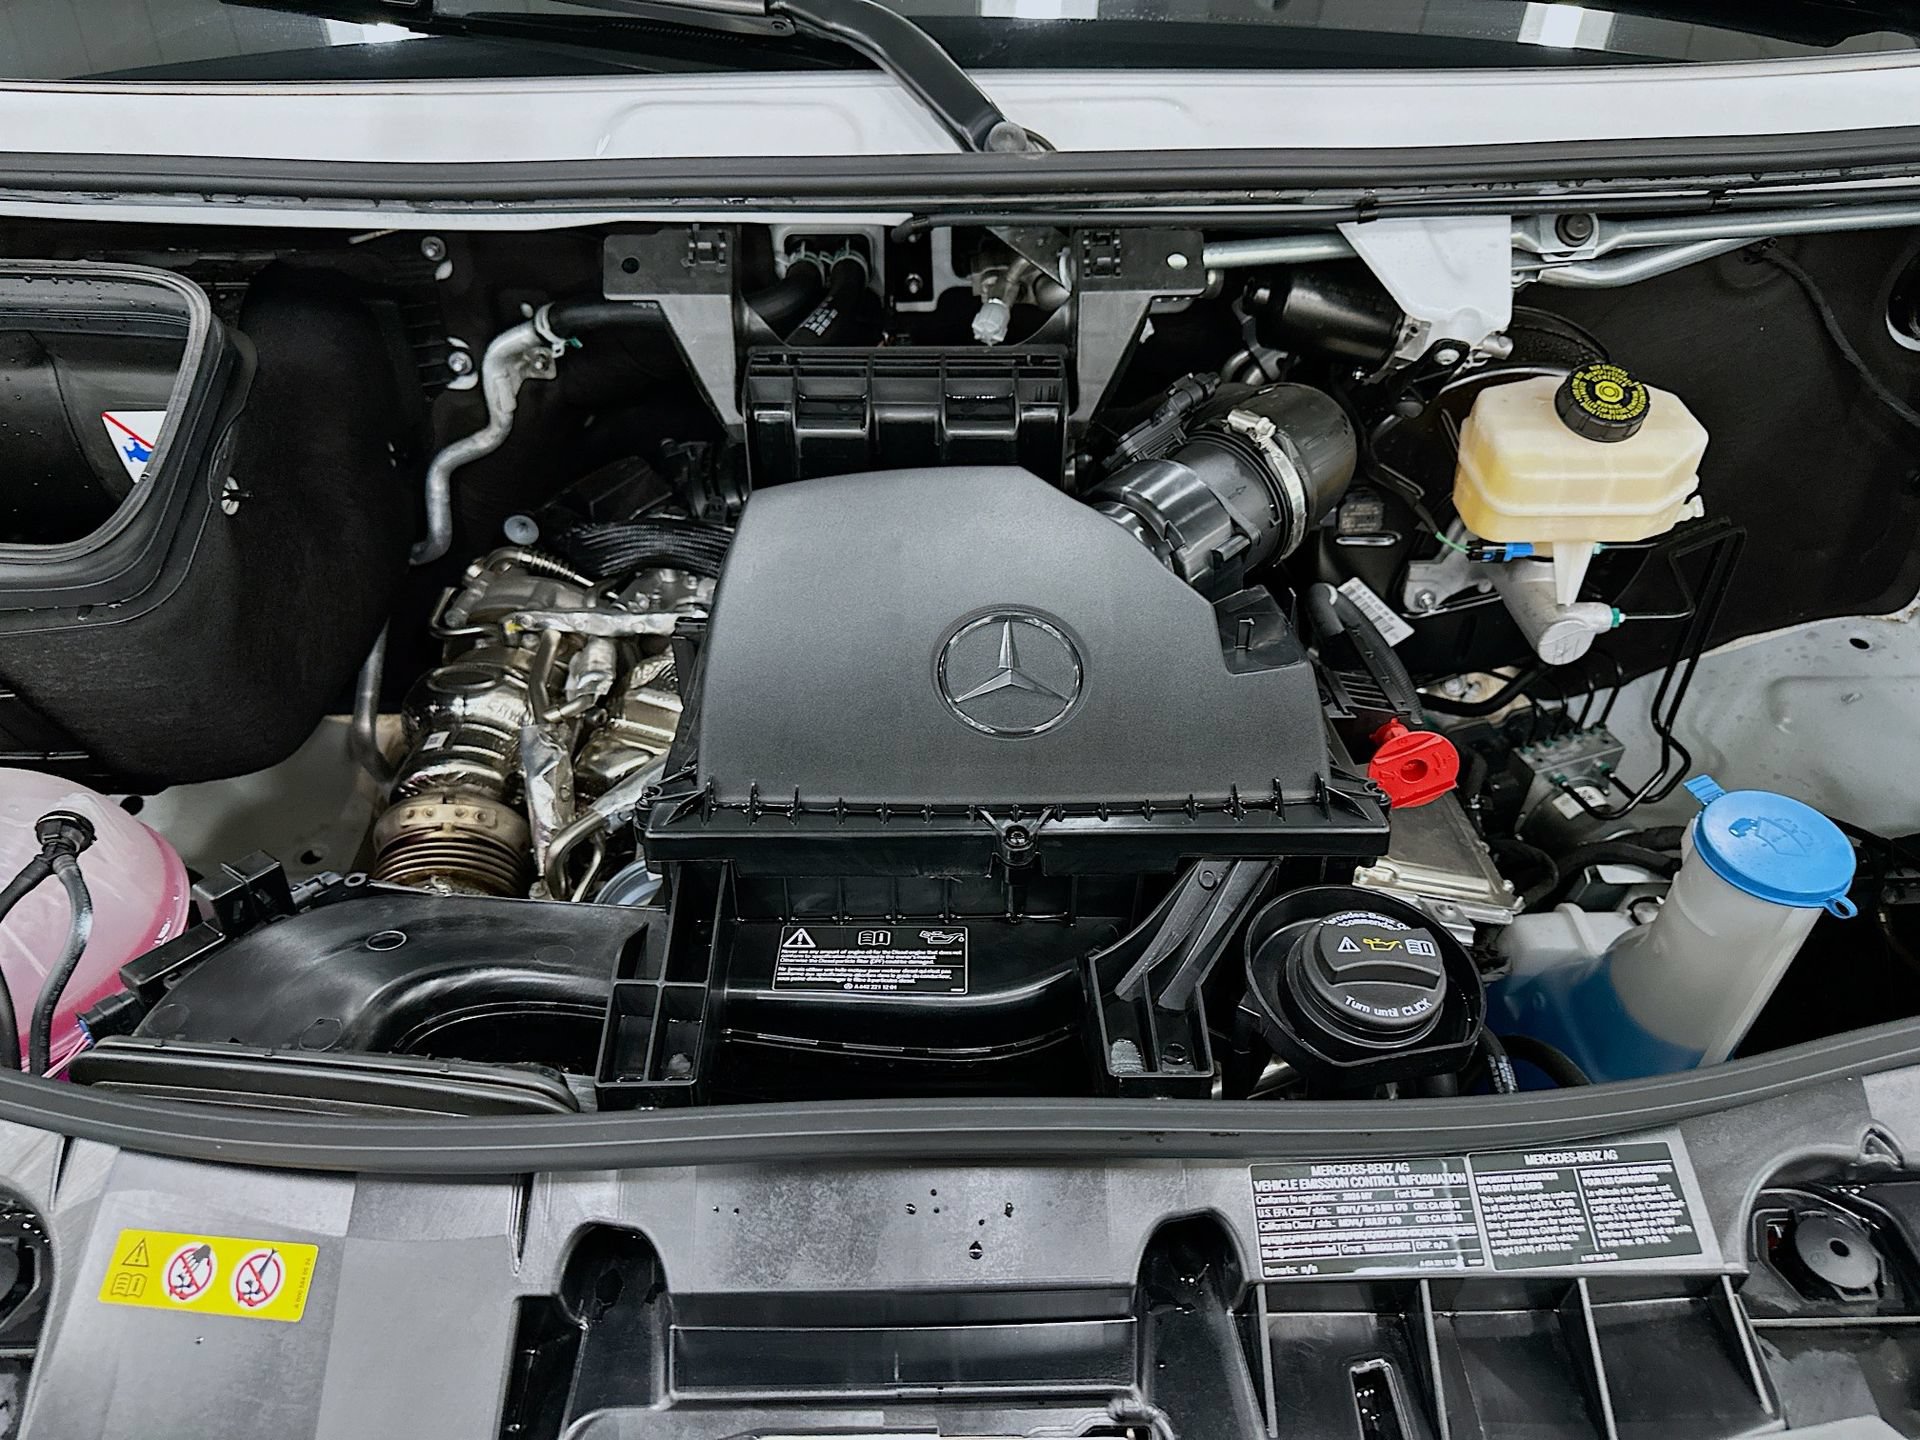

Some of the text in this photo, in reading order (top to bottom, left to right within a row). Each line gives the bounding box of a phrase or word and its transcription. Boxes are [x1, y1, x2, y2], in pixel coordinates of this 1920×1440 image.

[1345, 995, 1433, 1017] Turn until CLICK
[1524, 1149, 1618, 1164] MERCEDES-BENZ AG
[1311, 1162, 1409, 1175] MERCEDES-BENZ AG
[1253, 1172, 1466, 1191] VEHICLE EMISSION CONTROL INFORMATION
